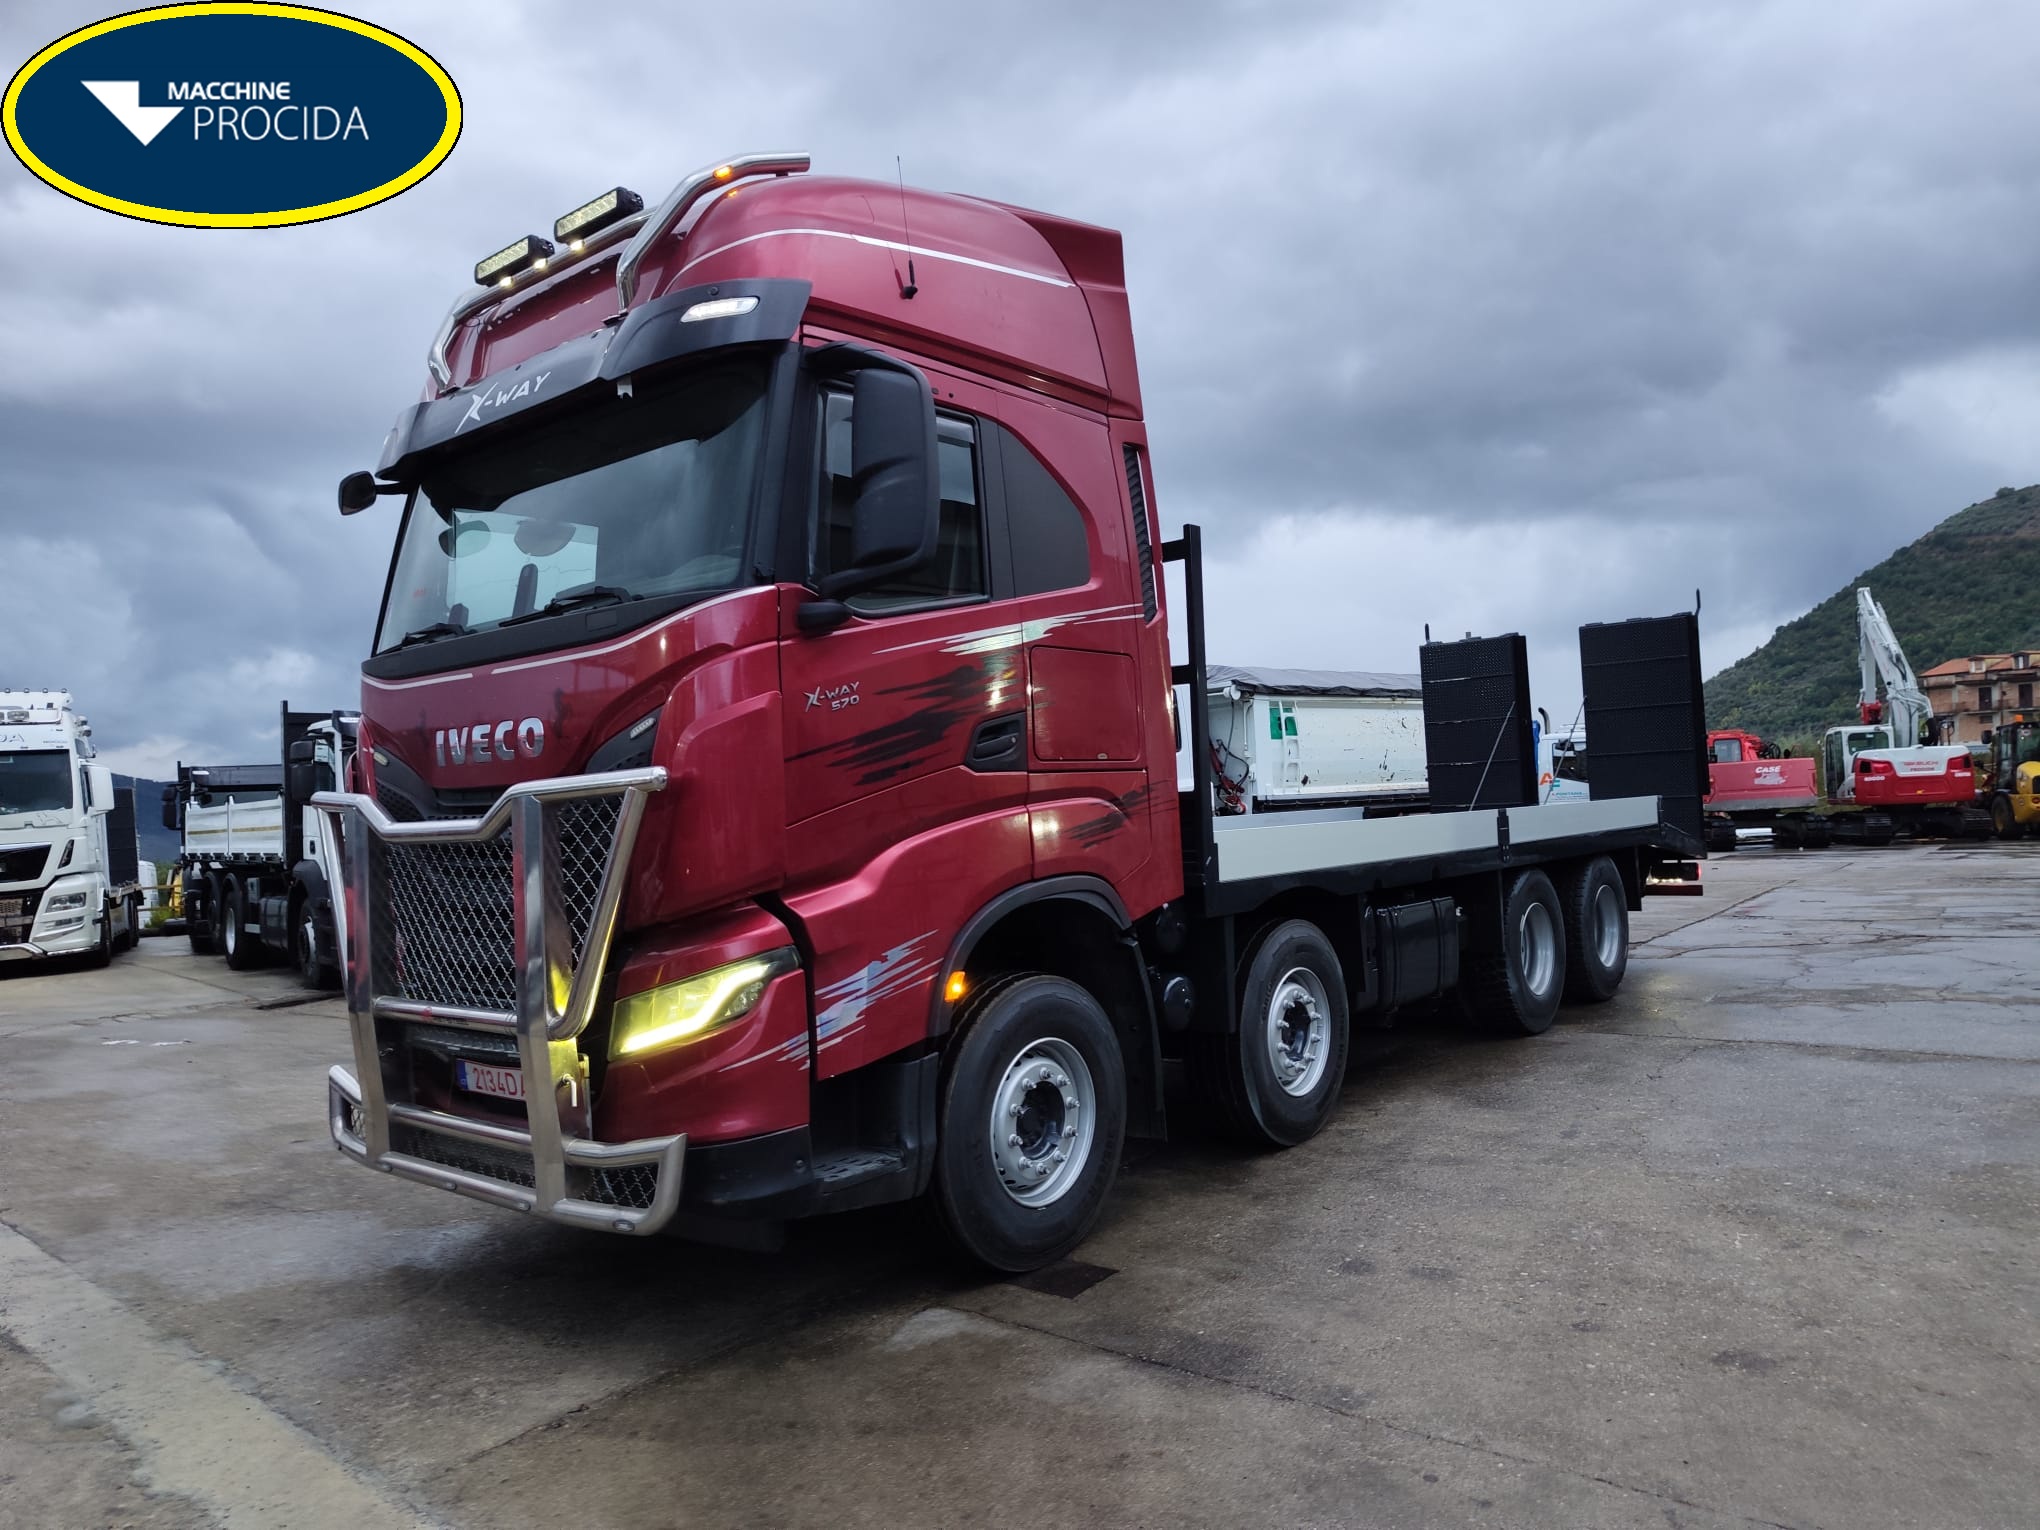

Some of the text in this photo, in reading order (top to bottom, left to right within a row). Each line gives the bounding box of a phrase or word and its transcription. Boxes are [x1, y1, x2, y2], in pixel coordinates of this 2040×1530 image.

[455, 371, 551, 433] X-WAY
[803, 681, 859, 712] X-WAY
[831, 695, 859, 711] 570
[435, 717, 544, 767] IVECO
[1755, 765, 1781, 773] CASE
